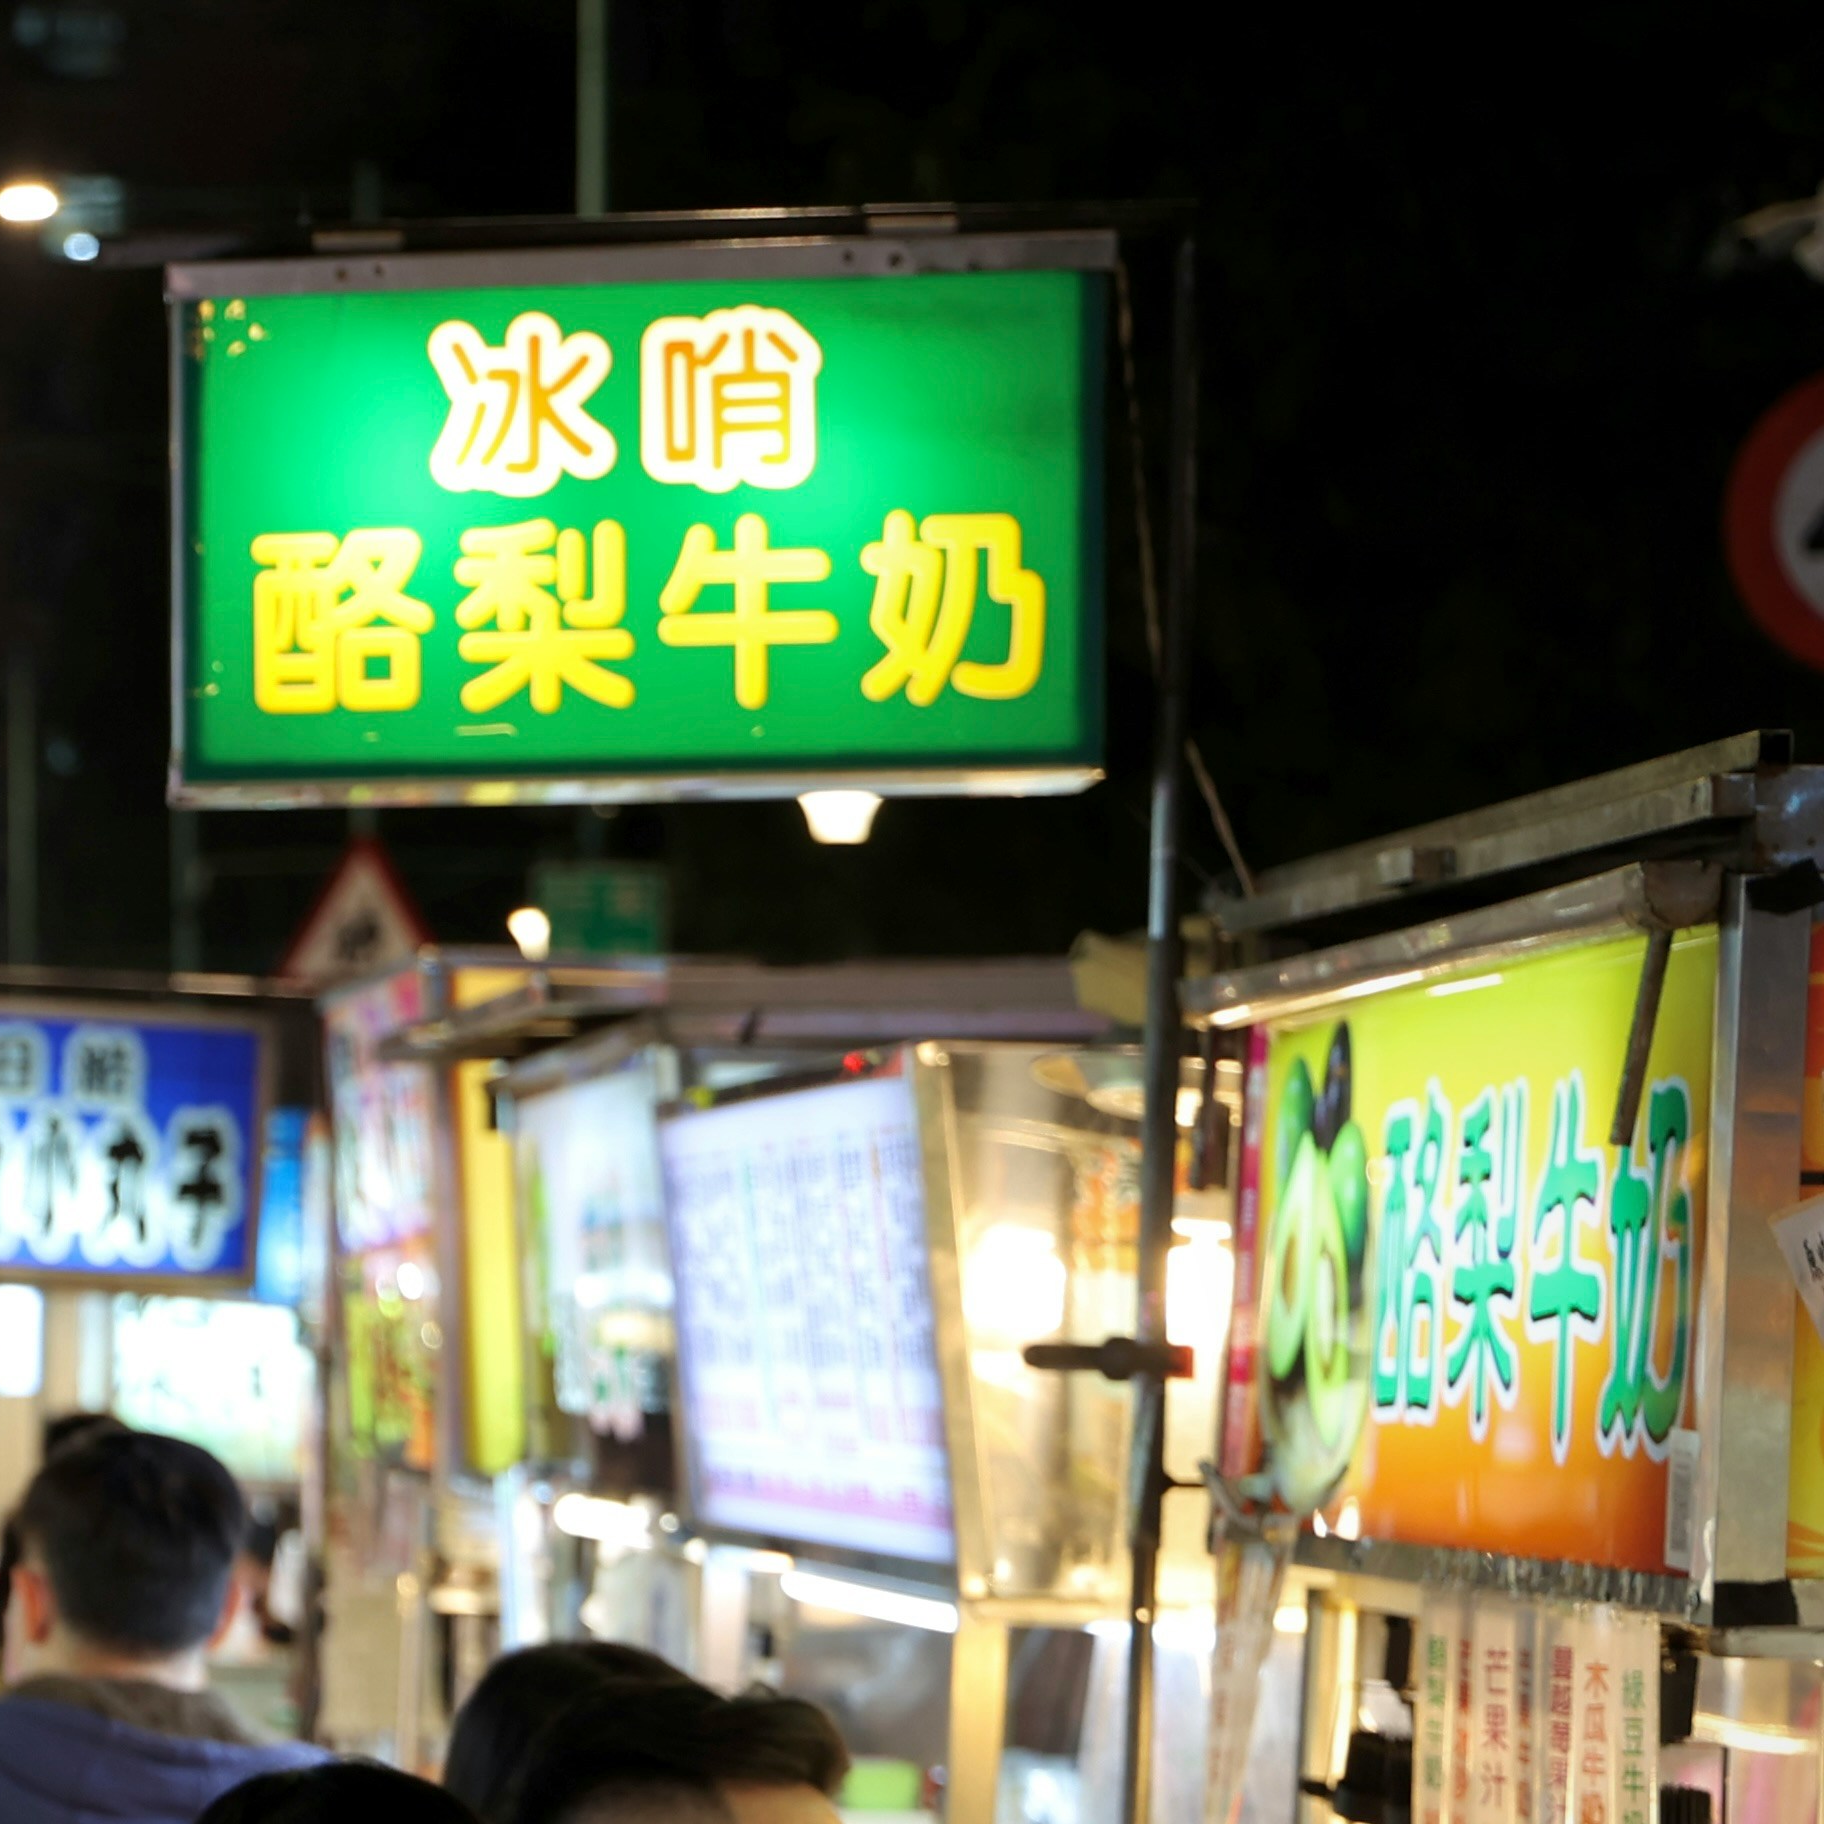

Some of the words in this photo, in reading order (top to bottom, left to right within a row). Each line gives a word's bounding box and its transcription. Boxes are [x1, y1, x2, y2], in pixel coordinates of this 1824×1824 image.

[432, 308, 819, 494] 冰哨
[250, 508, 1045, 715] 酪梨牛奶
[1373, 1072, 1690, 1462] 酪梨牛奶
[1482, 1648, 1509, 1806] 芒果汁
